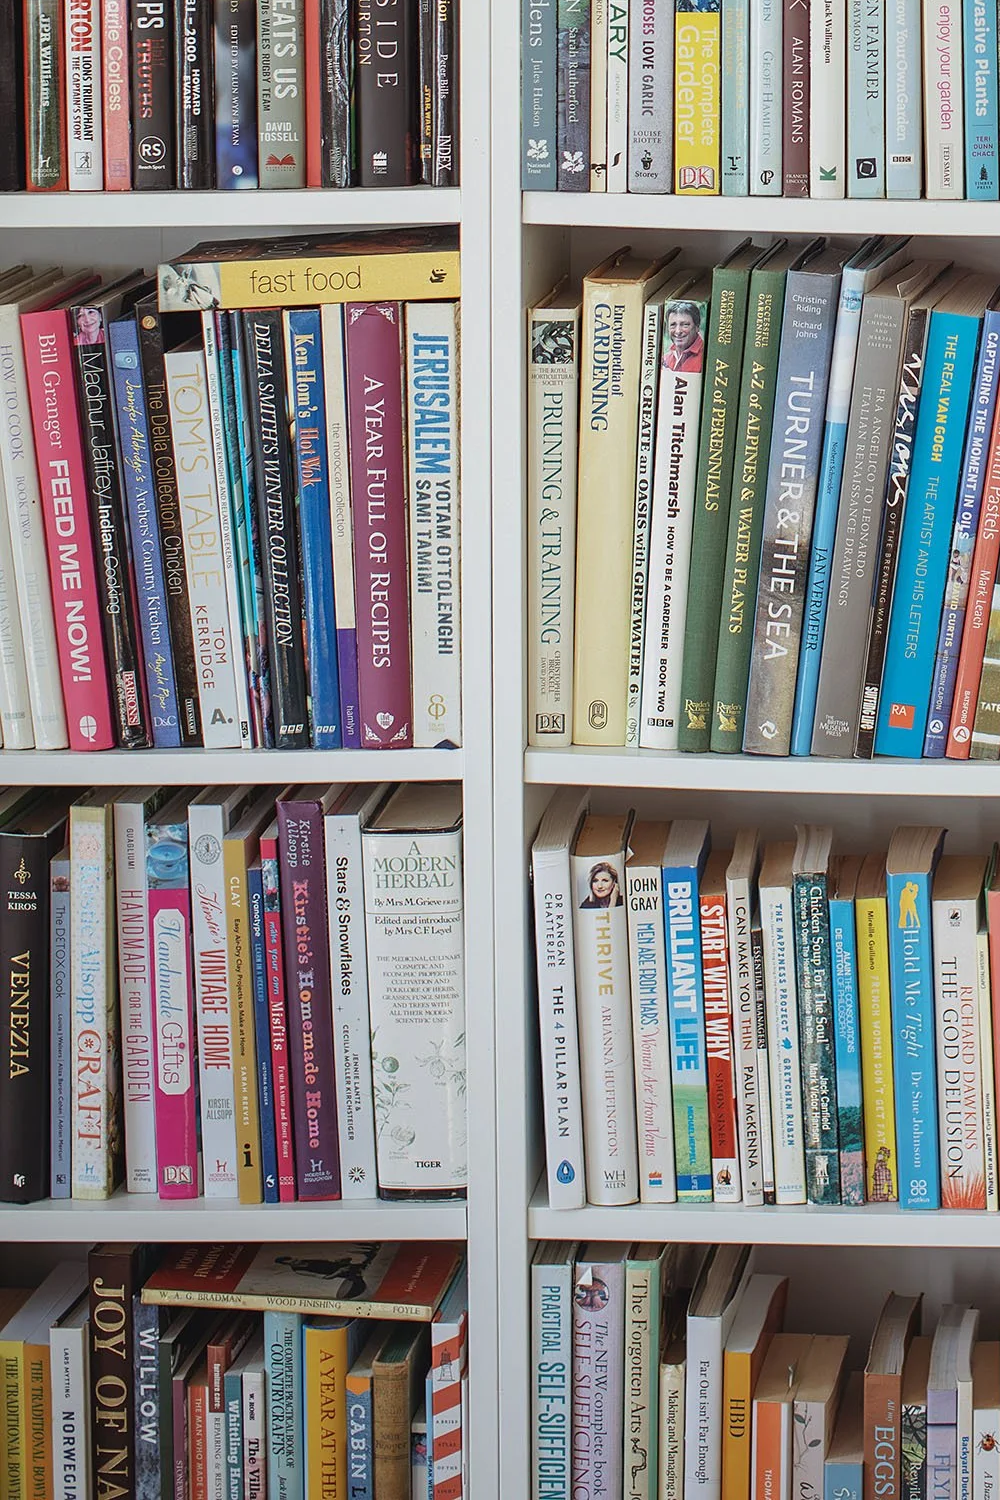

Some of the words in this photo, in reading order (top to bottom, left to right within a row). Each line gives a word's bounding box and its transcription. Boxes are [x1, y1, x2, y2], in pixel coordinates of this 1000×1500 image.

[273, 63, 298, 100] US
[973, 58, 989, 117] Plants
[260, 132, 299, 143] TOSSELL
[265, 122, 292, 132] DAVID
[249, 271, 296, 295] fast
[304, 266, 362, 293] food
[591, 302, 610, 433] GARDENING
[171, 363, 208, 474] TOM'S
[413, 332, 452, 474] JERUSALEM
[672, 377, 688, 421] Alan
[542, 391, 564, 502] PRUNING
[667, 422, 685, 519] Titchmarsh
[187, 488, 222, 589] TABLE
[540, 507, 561, 522] &
[541, 527, 562, 646] TRAINING
[373, 856, 456, 872] MODERN
[408, 841, 421, 855] A
[7, 891, 37, 900] TESSA
[336, 856, 349, 893] Stars
[376, 873, 454, 888] HERBAL
[629, 878, 658, 894] JOHN
[7, 901, 36, 911] KIROS
[337, 897, 351, 912] &
[630, 896, 659, 912] GRAY
[337, 914, 351, 996] Snowflakes
[594, 911, 614, 997] THRIVE
[667, 880, 697, 1013] BRILLIANT
[941, 957, 957, 999] THE
[9, 950, 31, 1080] VENEZIA
[942, 1009, 959, 1062] GOD
[674, 1017, 700, 1073] LIFE
[943, 1071, 963, 1180] DELUSION
[415, 1160, 442, 1169] TIGER
[92, 1276, 127, 1360] JOY
[94, 1376, 129, 1434] OF
[137, 1327, 158, 1446] WILLOW
[729, 1397, 746, 1439] HBD
